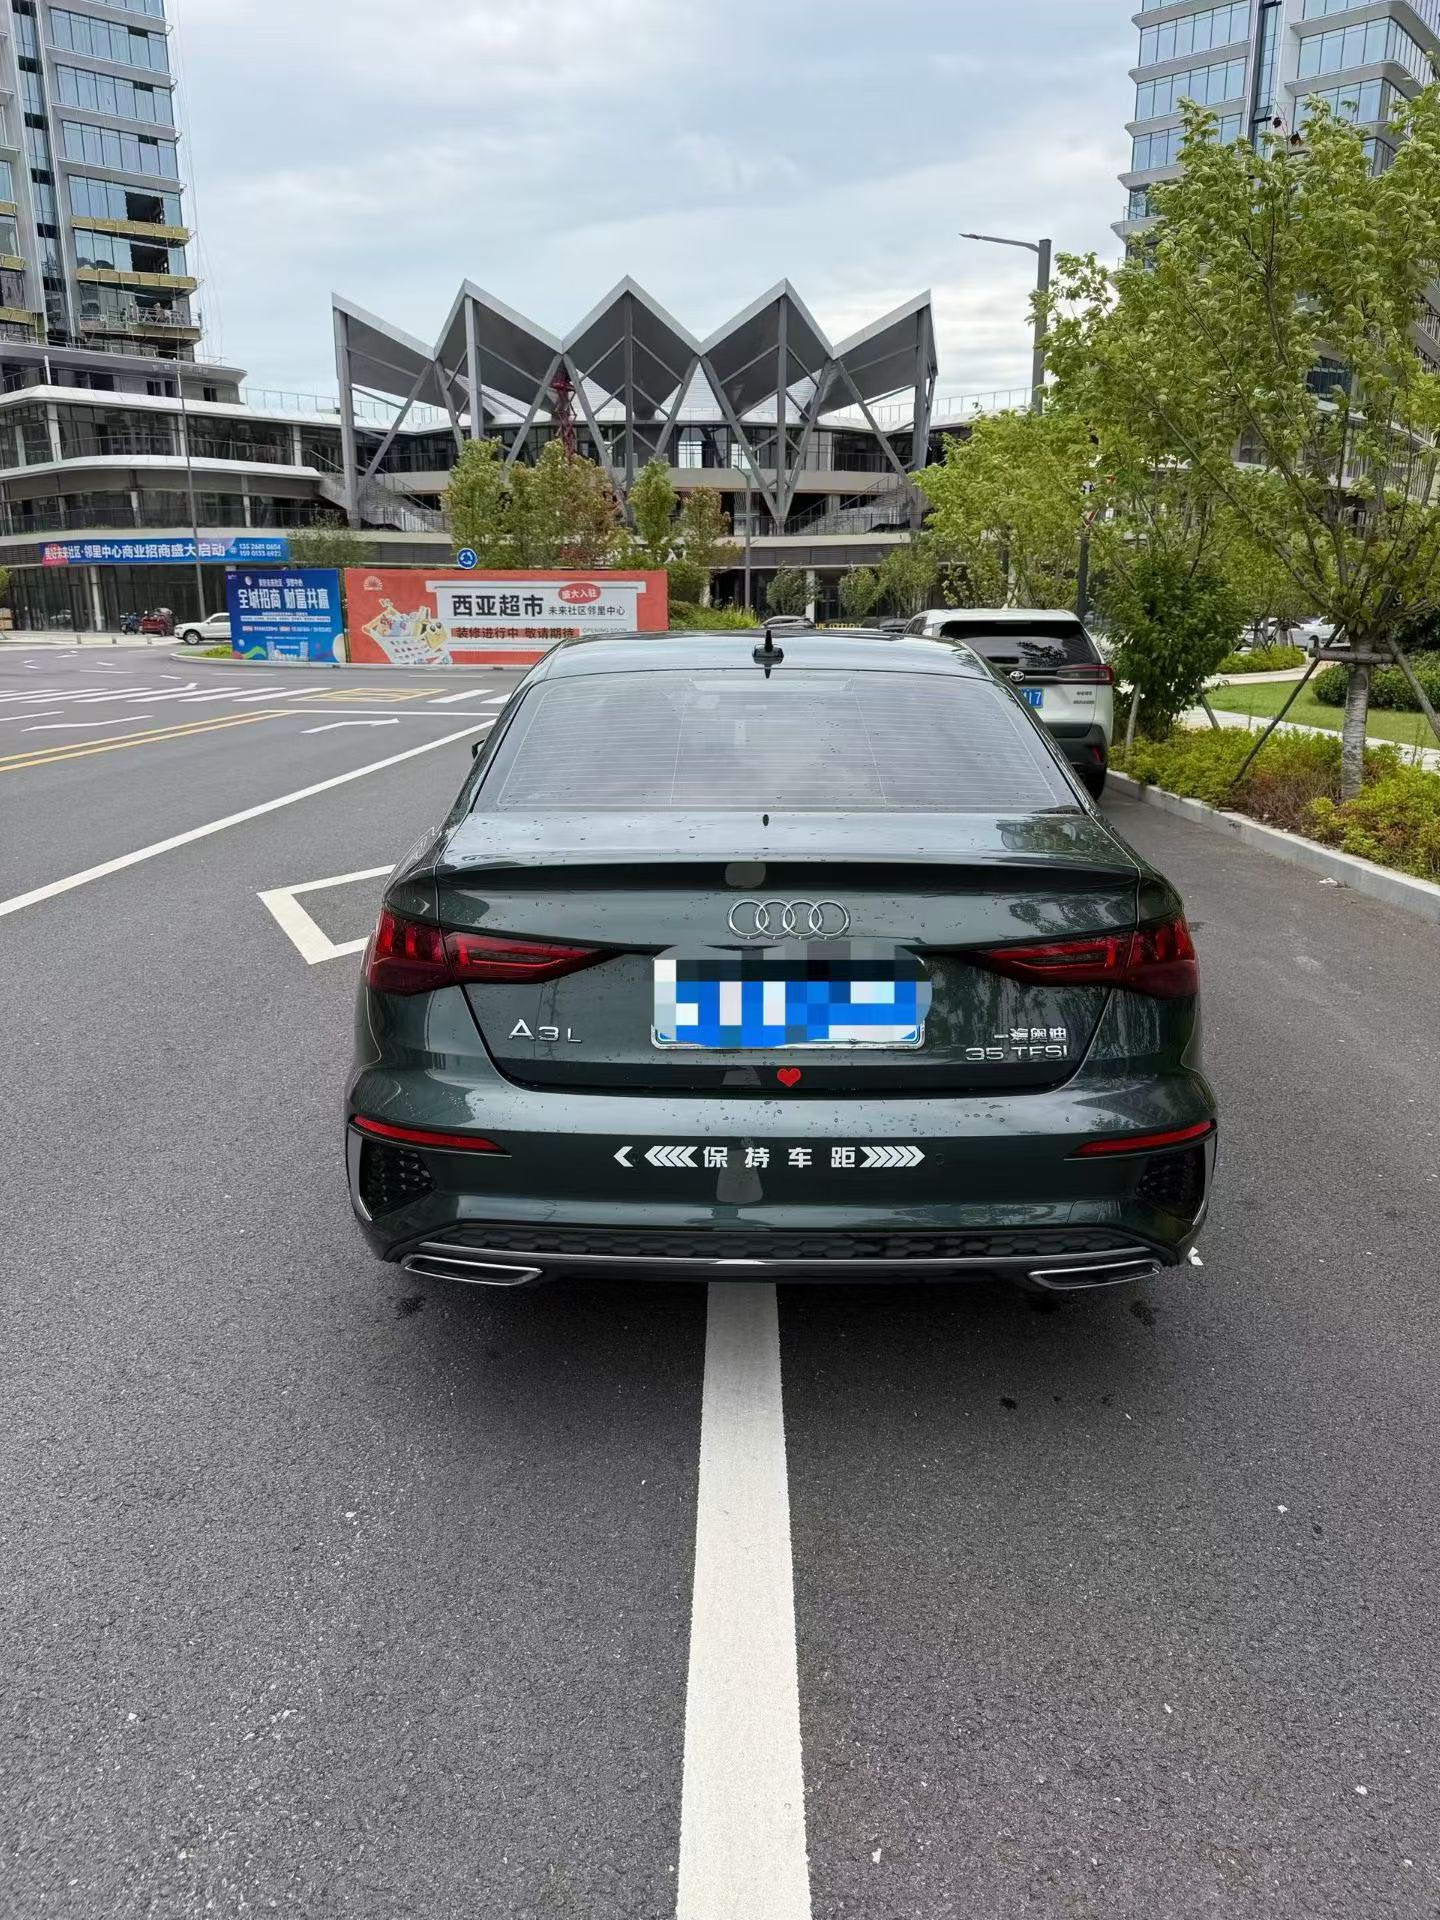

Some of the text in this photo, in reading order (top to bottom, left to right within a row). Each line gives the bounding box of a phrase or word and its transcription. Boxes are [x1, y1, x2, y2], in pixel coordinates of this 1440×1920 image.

[238, 588, 329, 609] 全城招商 财富共赢
[451, 594, 544, 617] 西亚超市
[548, 605, 626, 616] 未来社区邻里中心
[456, 627, 574, 639] 装修进行中 敬请期待
[994, 1027, 1067, 1042] 一汽奥迪
[966, 1045, 1068, 1061] 35 TFSI
[703, 1146, 856, 1168] 保持车距
